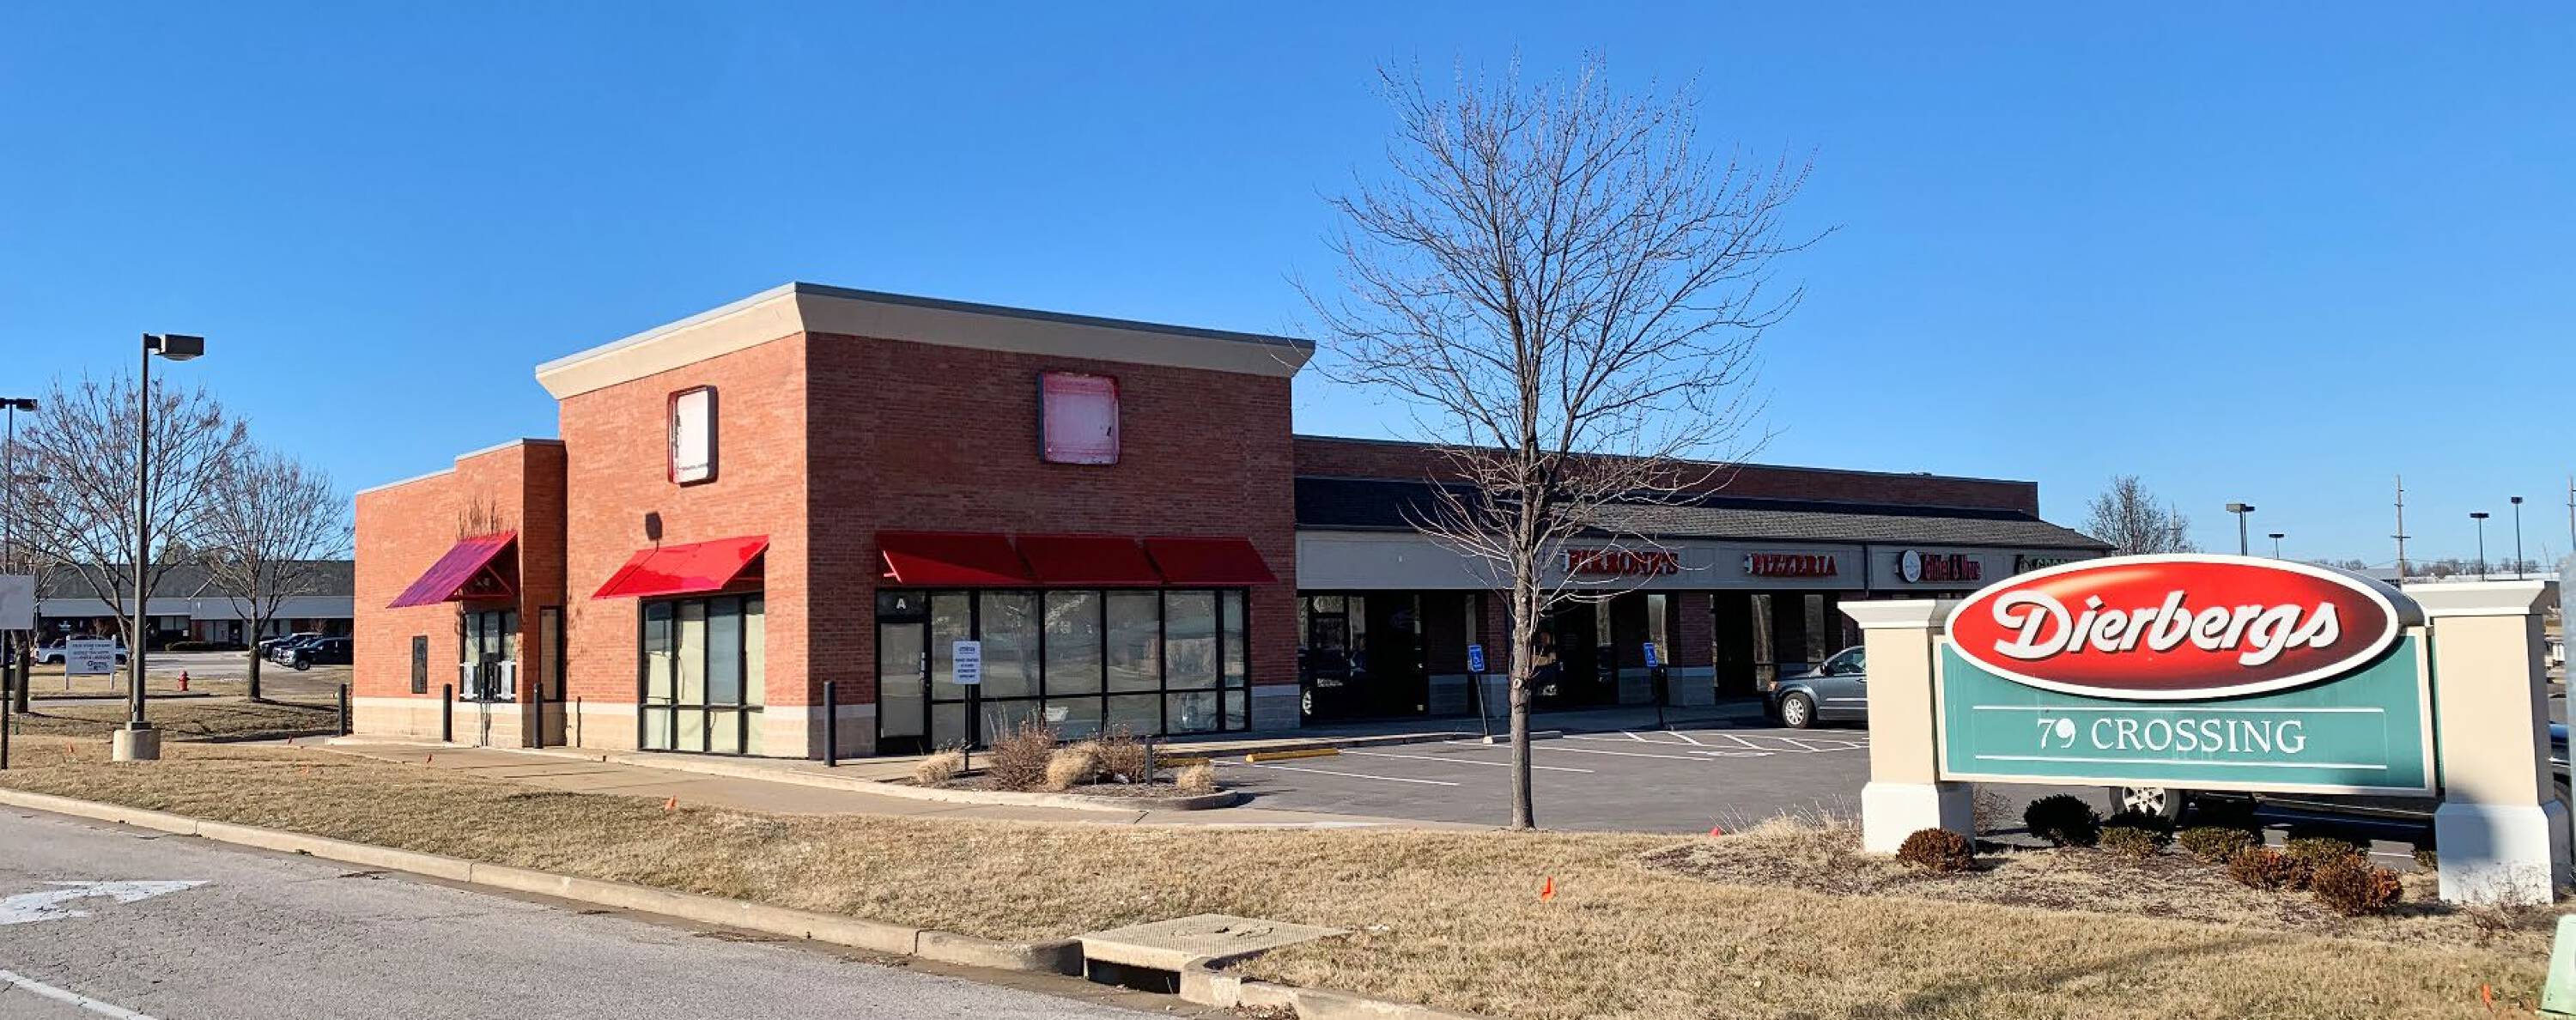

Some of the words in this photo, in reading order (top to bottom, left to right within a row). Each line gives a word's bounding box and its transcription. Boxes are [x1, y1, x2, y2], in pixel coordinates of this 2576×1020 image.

[896, 598, 907, 610] A
[1992, 590, 2341, 666] Dierbergs
[2037, 717, 2076, 750] 79
[2091, 718, 2307, 753] CROSSING
